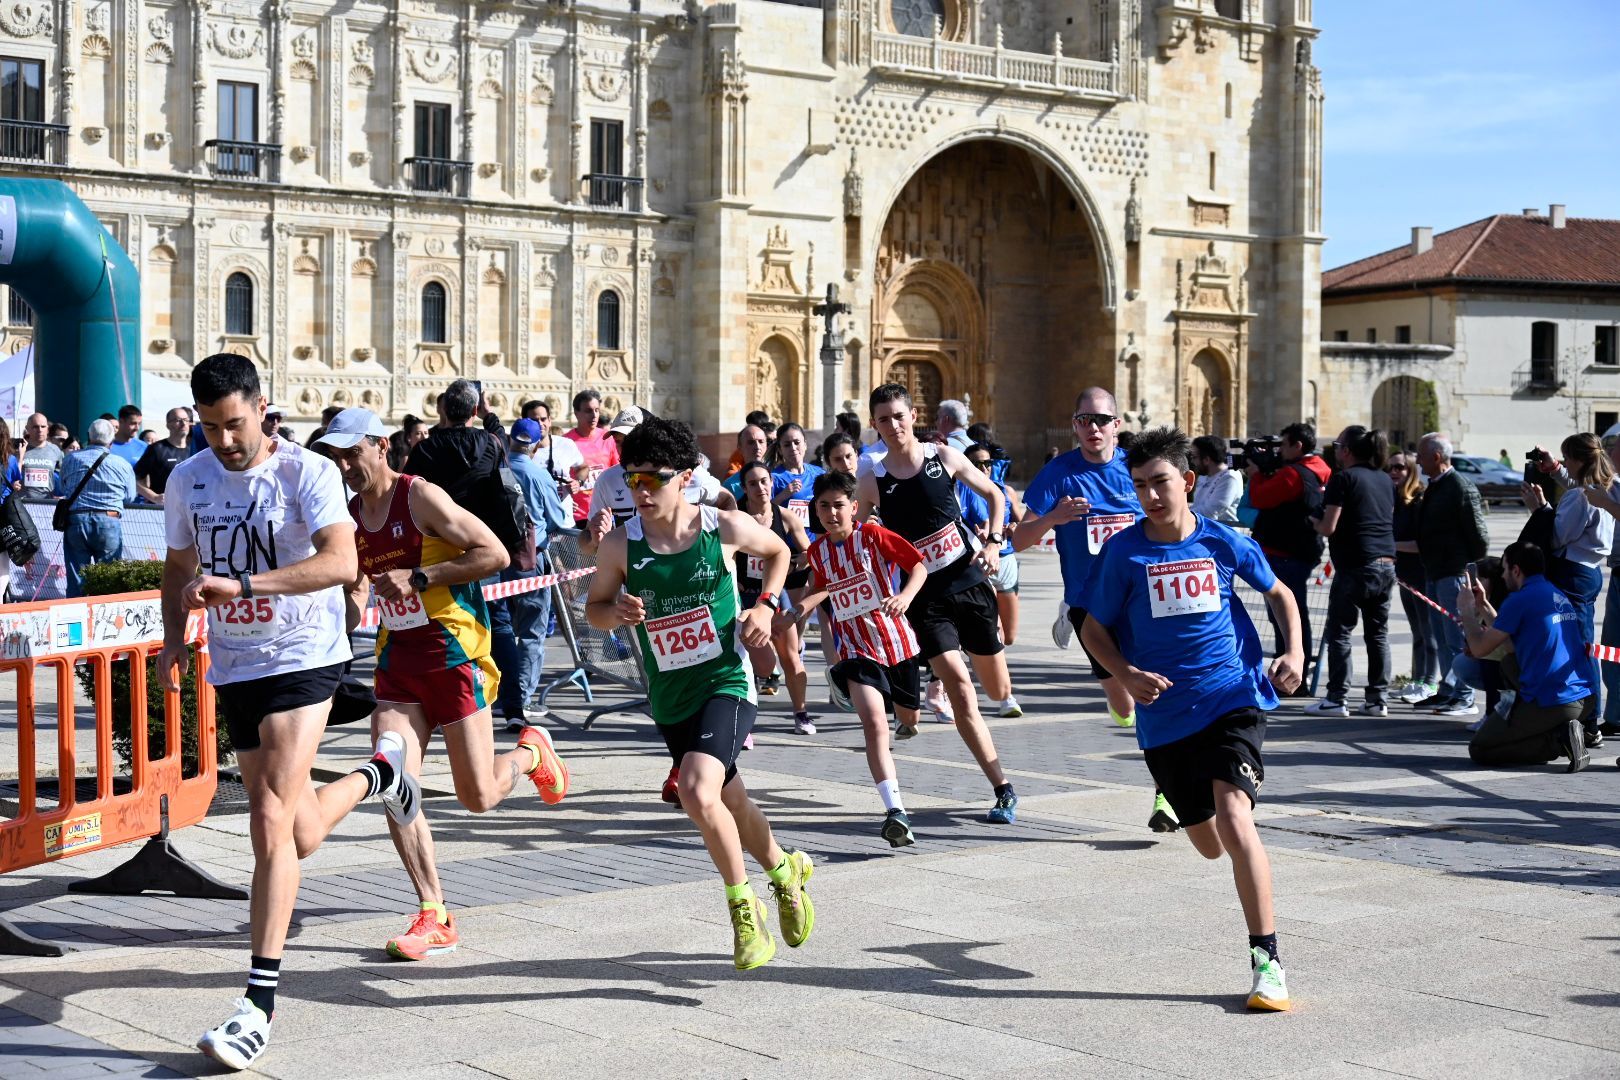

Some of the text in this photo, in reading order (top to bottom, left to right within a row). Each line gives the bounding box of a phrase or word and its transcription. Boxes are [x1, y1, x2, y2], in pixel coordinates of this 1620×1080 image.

[26, 473, 48, 481] 1159
[198, 516, 216, 524] MEDIA
[194, 501, 278, 577] LEÓN
[922, 533, 961, 563] 1246
[661, 591, 716, 606] universidad
[832, 584, 873, 610] 1079
[1153, 574, 1216, 601] 1104
[214, 598, 274, 624] 1235
[376, 592, 422, 618] 1183
[664, 616, 686, 626] CASTILLA
[691, 610, 706, 619] LEÓN
[654, 622, 715, 656] 1264
